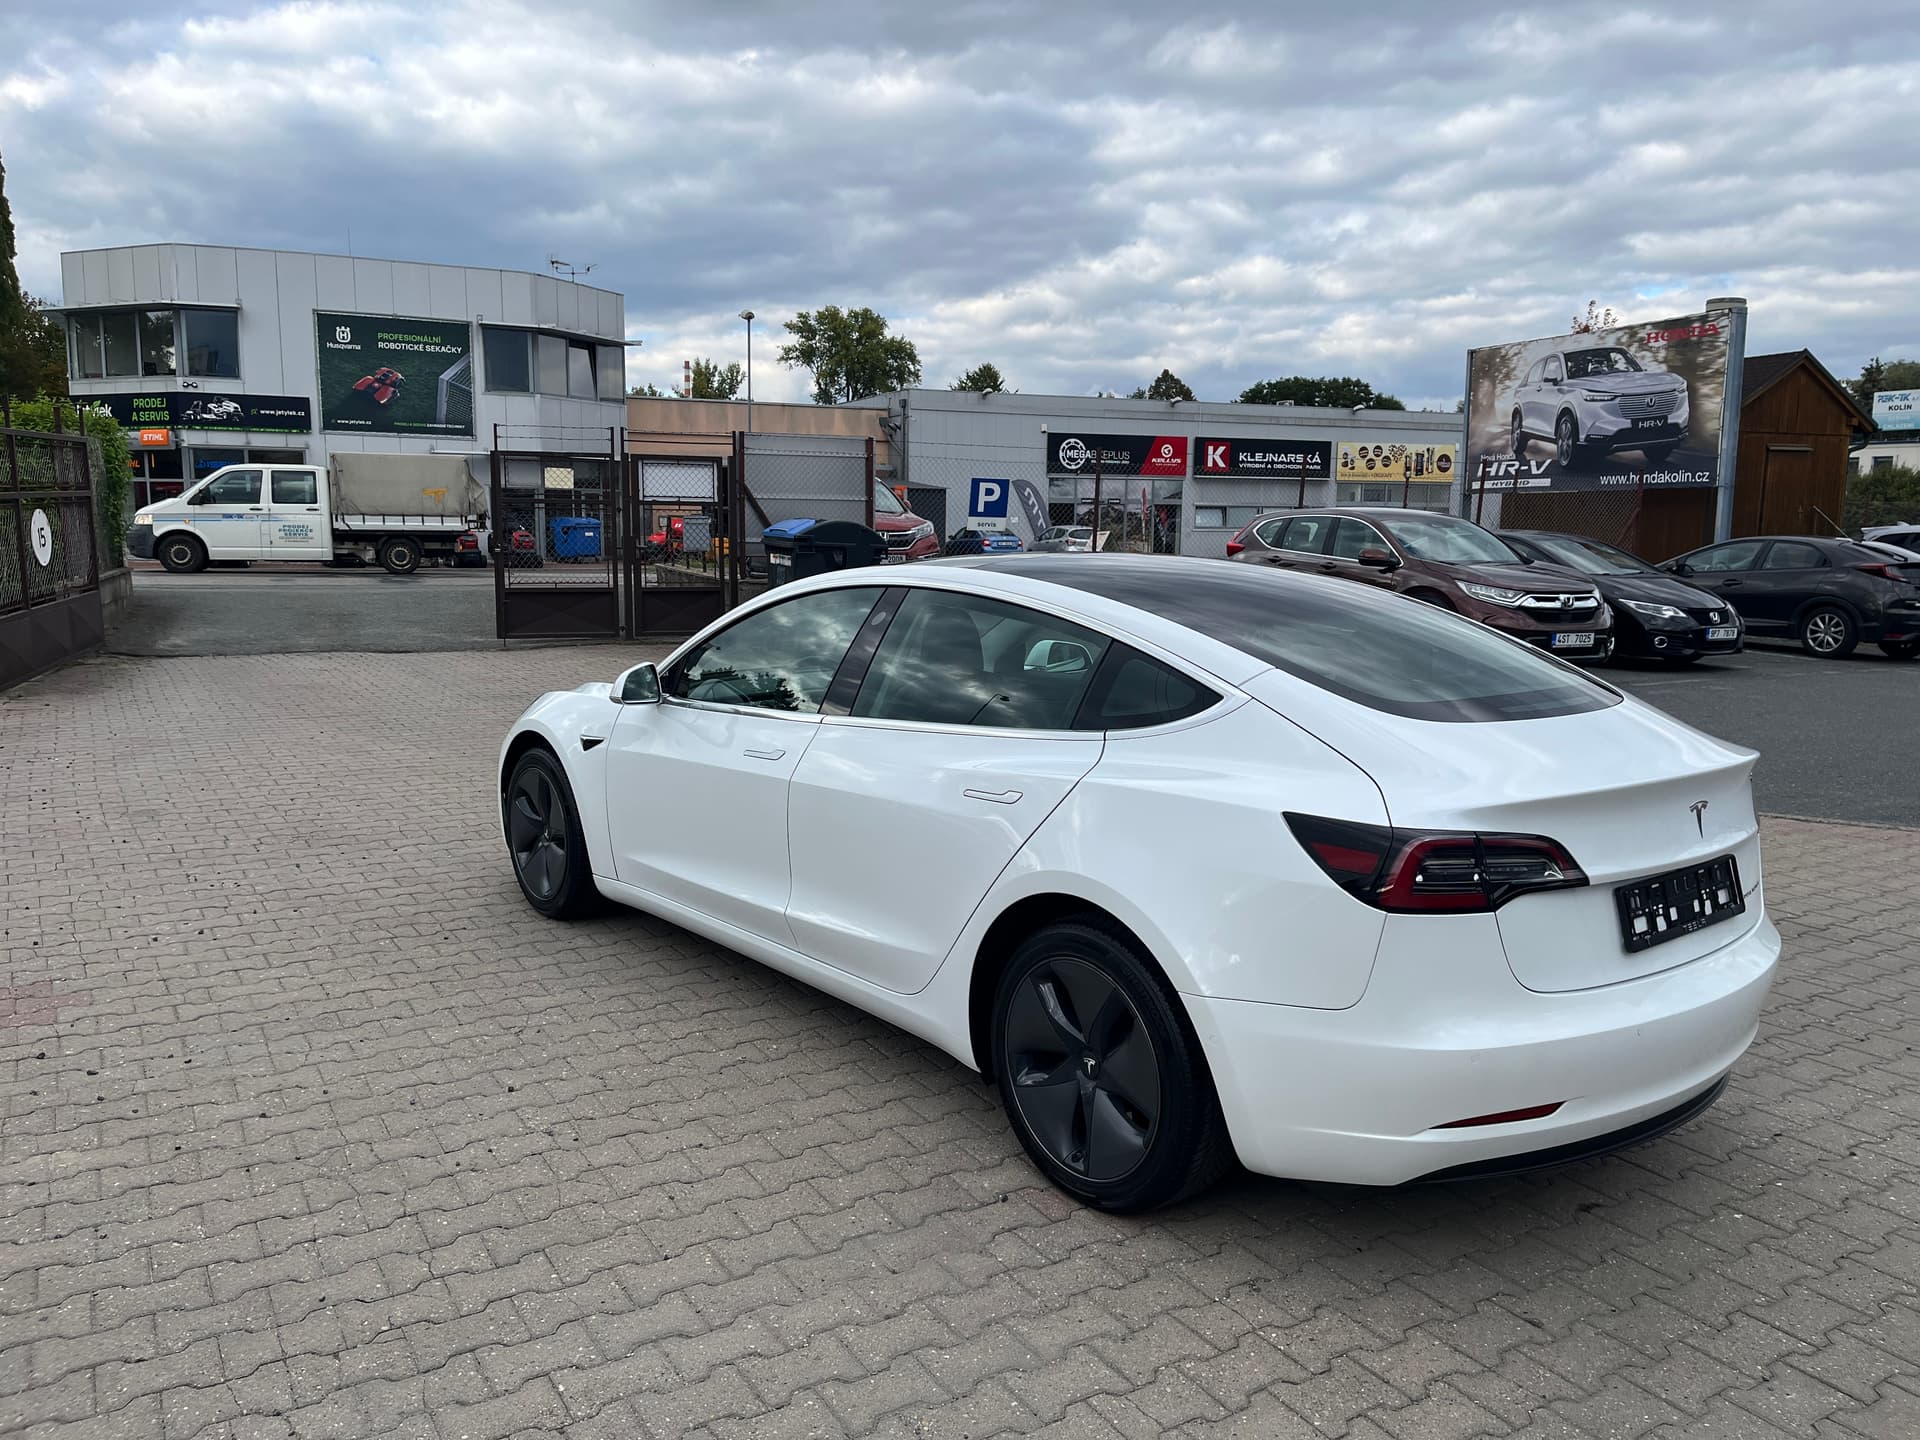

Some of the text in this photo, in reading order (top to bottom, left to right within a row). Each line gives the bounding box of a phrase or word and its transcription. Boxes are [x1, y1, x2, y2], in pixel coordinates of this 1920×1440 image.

[377, 332, 441, 343] PROFESIONÁLNÍ
[1646, 324, 1720, 344] HONDA
[326, 342, 361, 350] Husqvarna
[377, 342, 462, 354] ROBOTICKÉ SEKAČKY
[133, 398, 166, 408] PRODEJ
[132, 411, 170, 421] A SERVIS
[1639, 420, 1664, 428] HR-V
[1207, 445, 1226, 467] K
[1477, 459, 1552, 477] HR-V
[977, 482, 1001, 513] P
[1557, 632, 1591, 644] 4ST 7025
